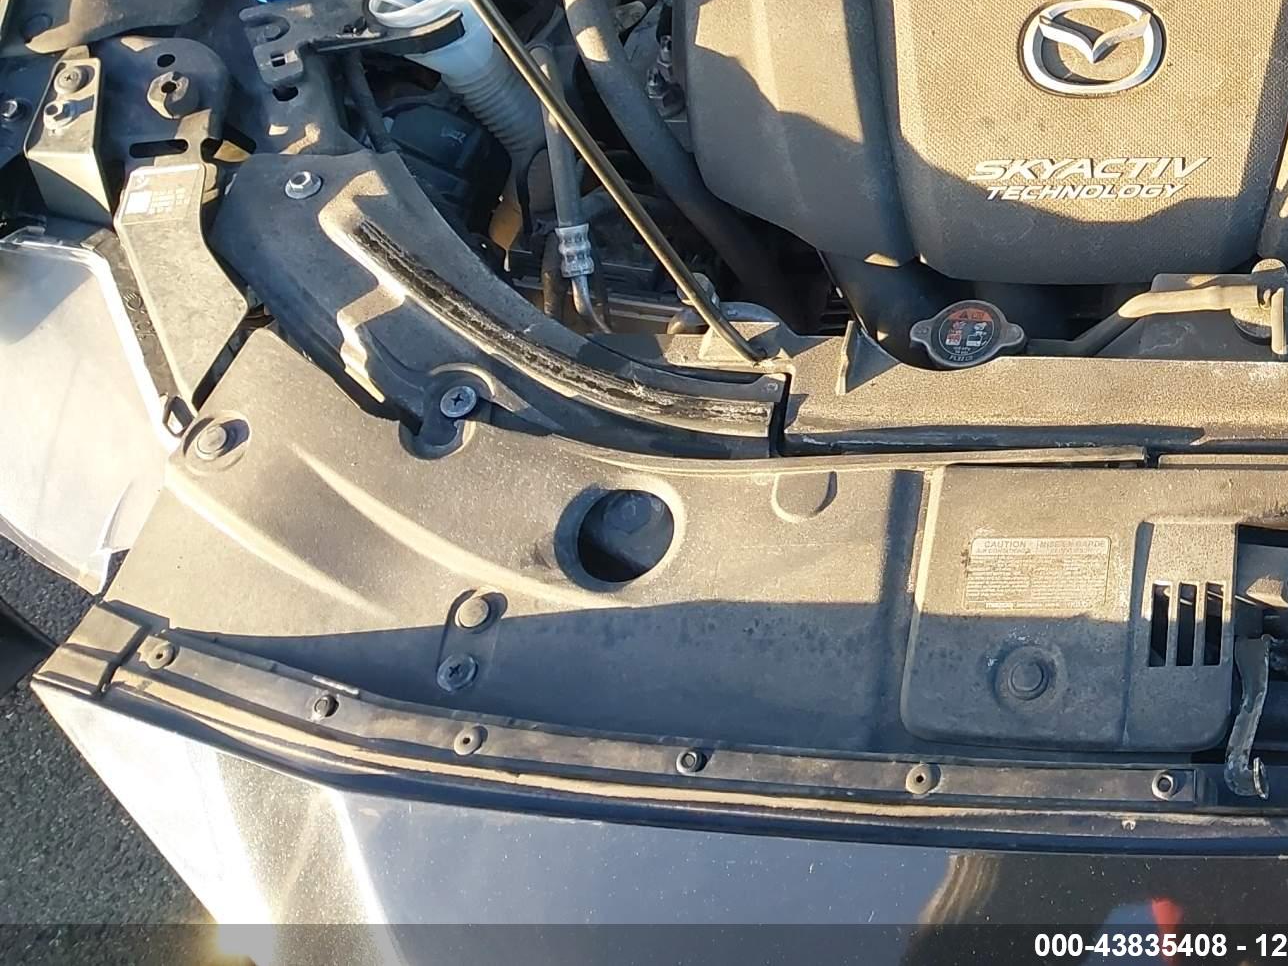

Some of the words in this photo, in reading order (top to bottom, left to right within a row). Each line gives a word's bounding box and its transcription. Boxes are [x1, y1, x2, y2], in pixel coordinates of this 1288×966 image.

[967, 157, 1211, 180] SKYACTIV
[986, 184, 1191, 201] TECHNOLOGY
[984, 540, 1026, 548] CAUTION
